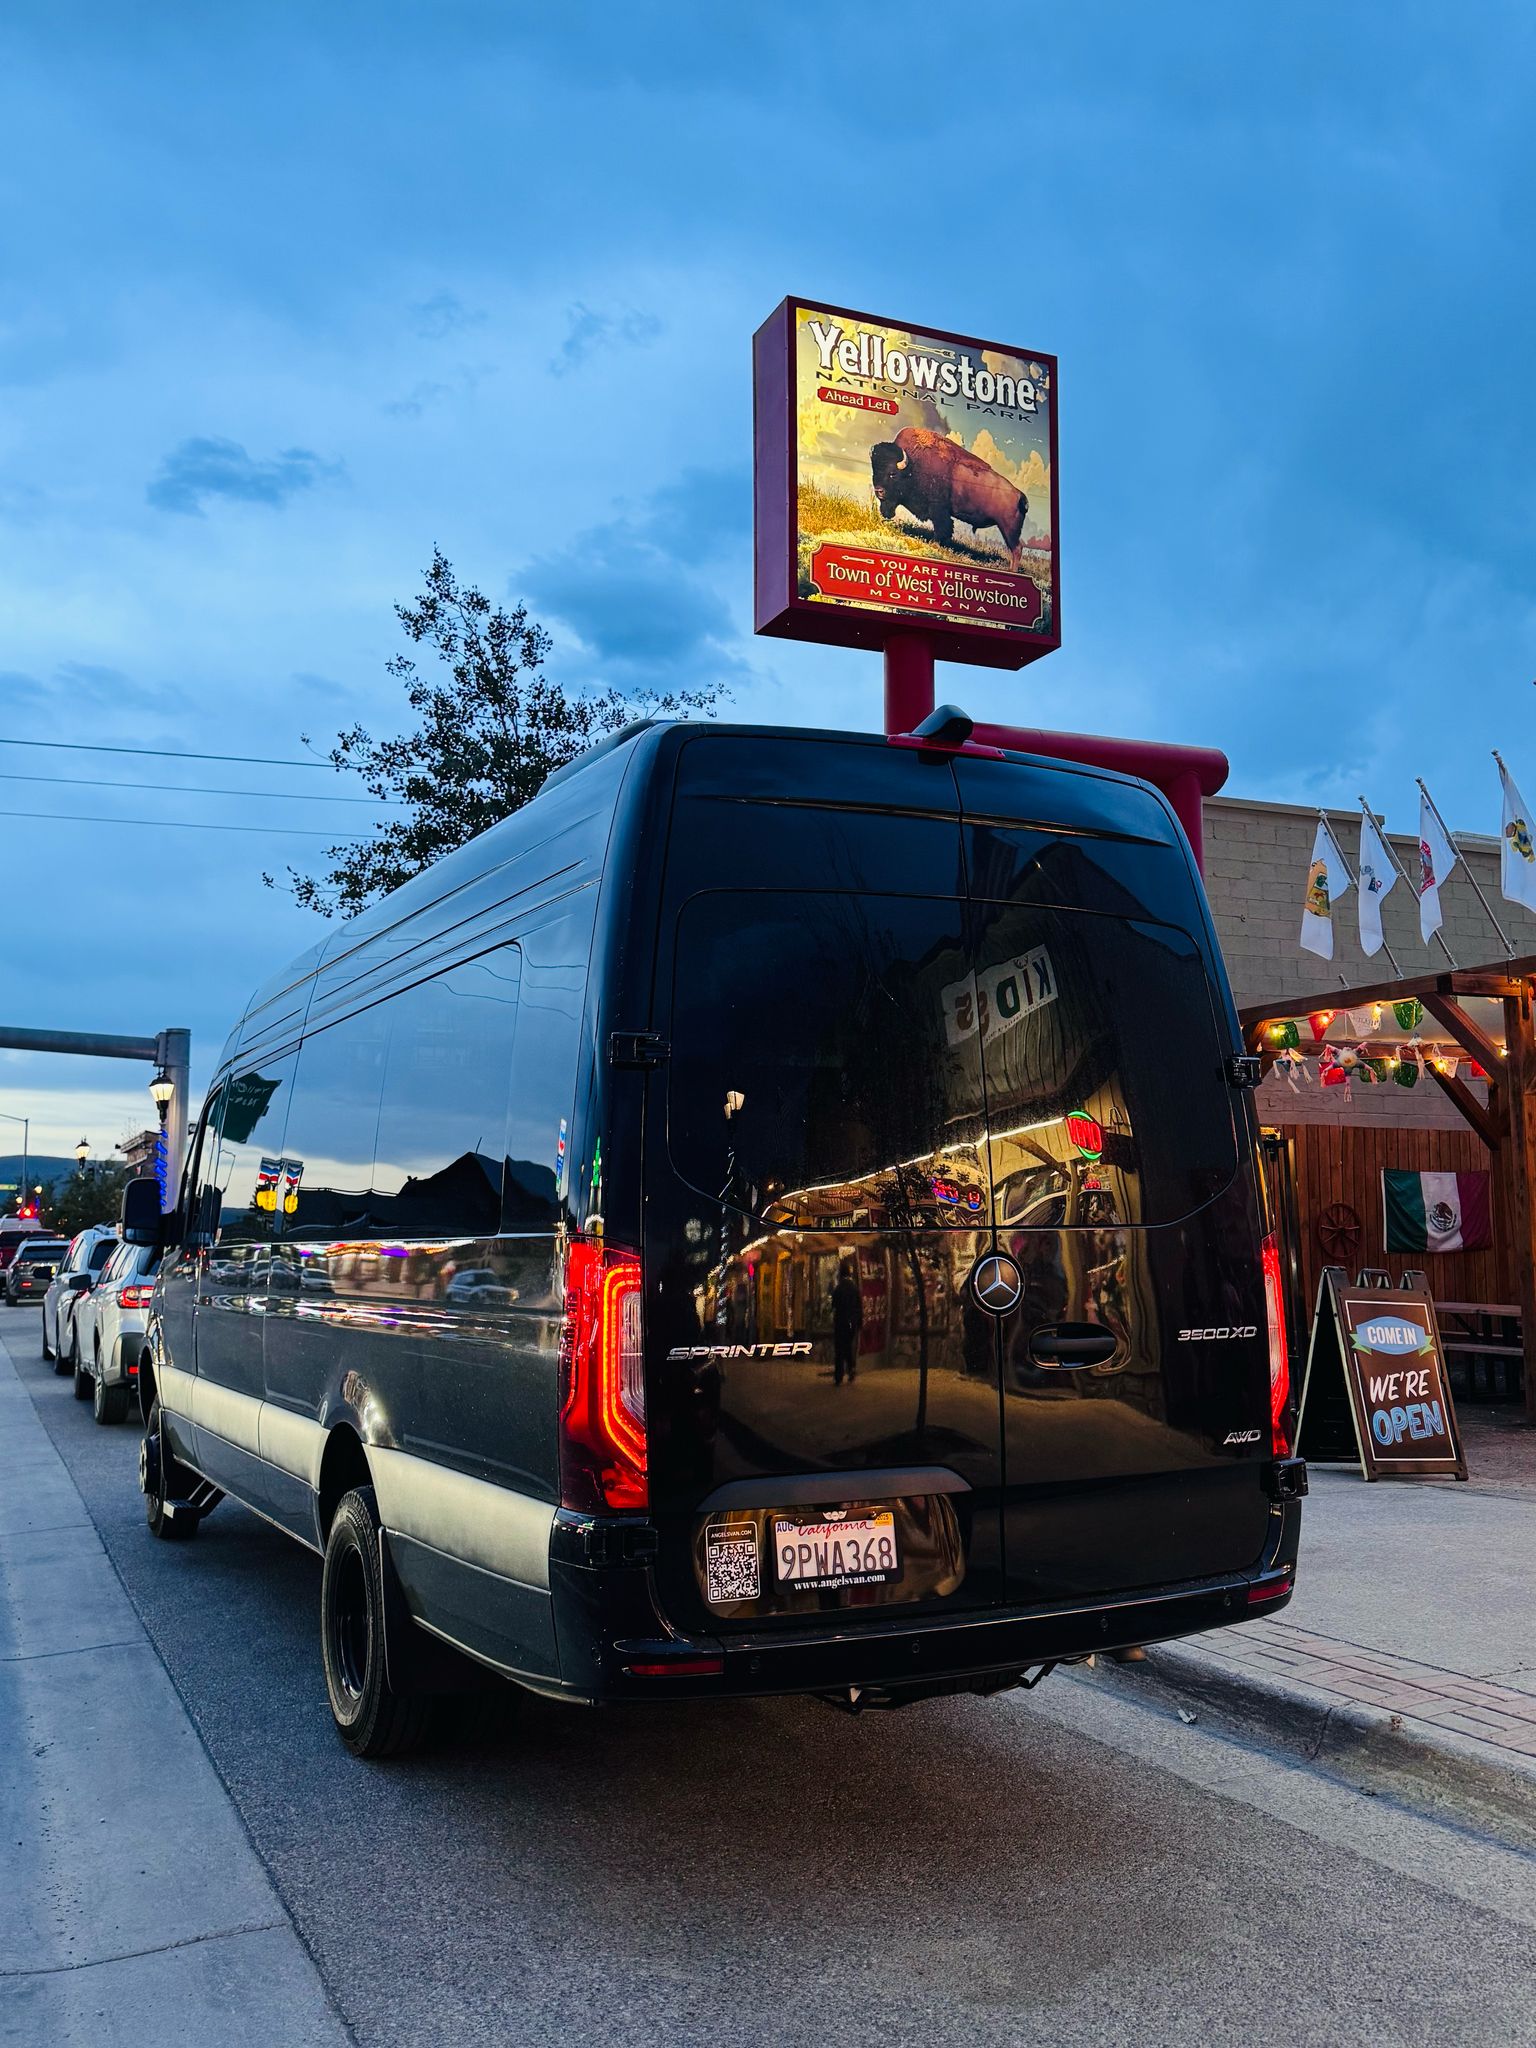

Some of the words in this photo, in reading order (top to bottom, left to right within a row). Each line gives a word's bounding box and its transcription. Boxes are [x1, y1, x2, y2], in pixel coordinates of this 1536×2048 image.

[808, 321, 1038, 414] Yellowstone
[816, 371, 954, 407] NATIONAL
[967, 403, 1032, 424] PARK
[825, 390, 864, 406] Ahead
[868, 398, 891, 412] Left
[880, 559, 907, 571] YOU
[912, 566, 939, 577] ARE
[944, 570, 980, 583] HERE
[826, 562, 870, 584] Town
[875, 571, 892, 588] of
[895, 573, 933, 594] West
[938, 580, 1028, 609] Yellowstone
[869, 589, 987, 613] MONTANA
[1177, 1326, 1258, 1341] 3500XD
[1366, 1326, 1403, 1345] COME
[1403, 1327, 1417, 1345] IN
[666, 1342, 813, 1361] SPRINTER
[1369, 1369, 1431, 1403] WE'RE
[1372, 1400, 1445, 1446] OPEN
[1223, 1429, 1261, 1445] AWD
[711, 1530, 752, 1538] ANGELSVAN.COM
[776, 1523, 794, 1533] AUG
[798, 1520, 875, 1539] California
[781, 1537, 893, 1580] 9PWA368
[794, 1573, 886, 1591] www.angelsvan.com
